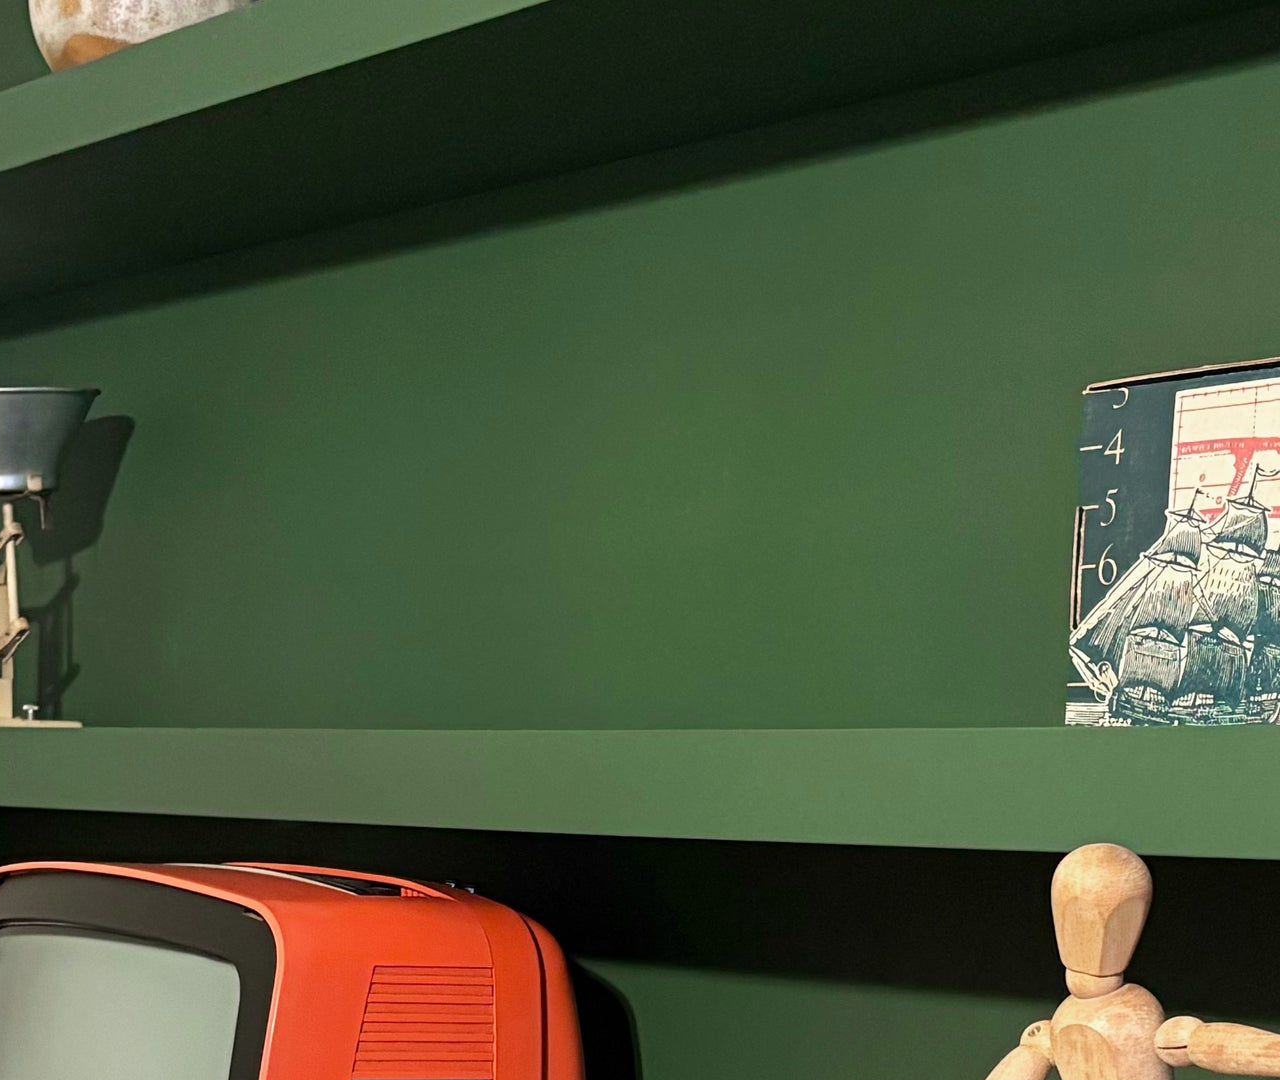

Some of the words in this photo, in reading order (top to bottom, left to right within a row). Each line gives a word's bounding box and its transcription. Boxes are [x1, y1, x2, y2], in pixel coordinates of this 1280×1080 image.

[1104, 428, 1125, 465] 4
[1100, 488, 1119, 527] 5
[1098, 543, 1118, 585] 6
